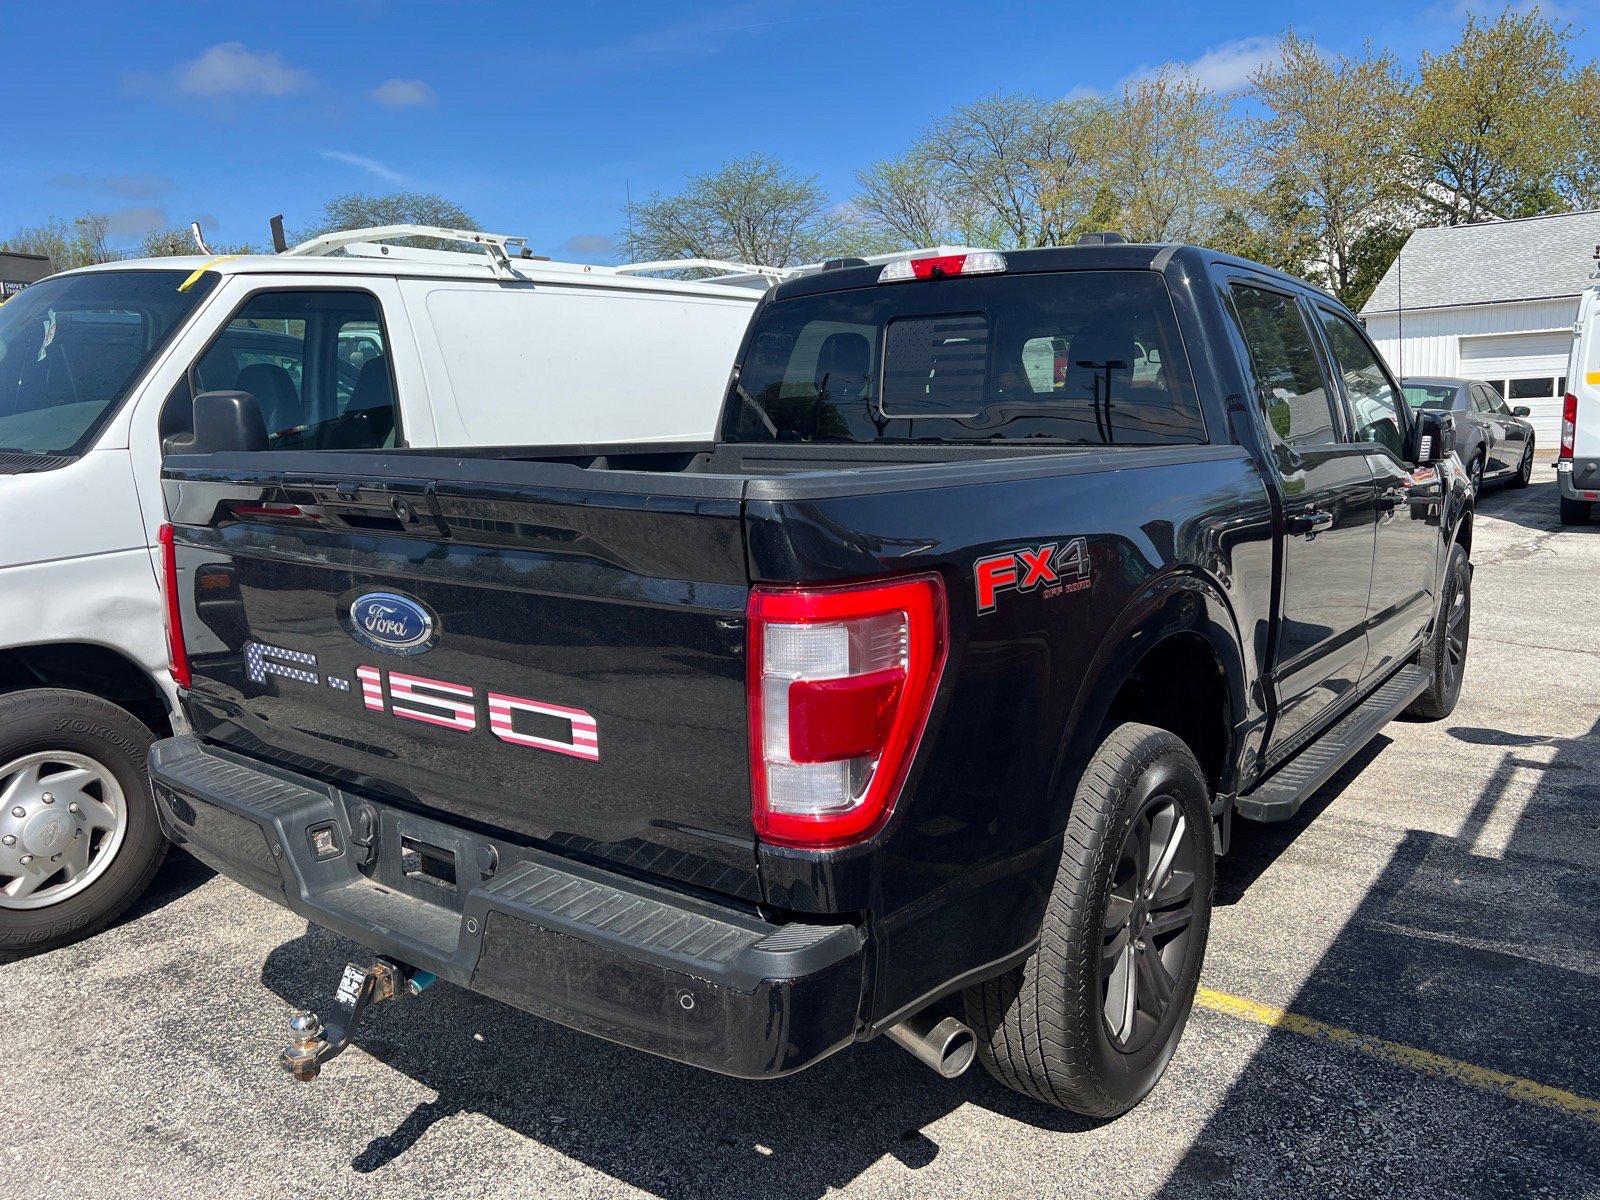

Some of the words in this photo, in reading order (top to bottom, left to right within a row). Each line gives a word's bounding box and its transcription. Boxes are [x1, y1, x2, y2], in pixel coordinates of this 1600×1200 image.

[973, 537, 1091, 616] FX4
[364, 603, 408, 637] Ford
[245, 641, 600, 763] F-150
